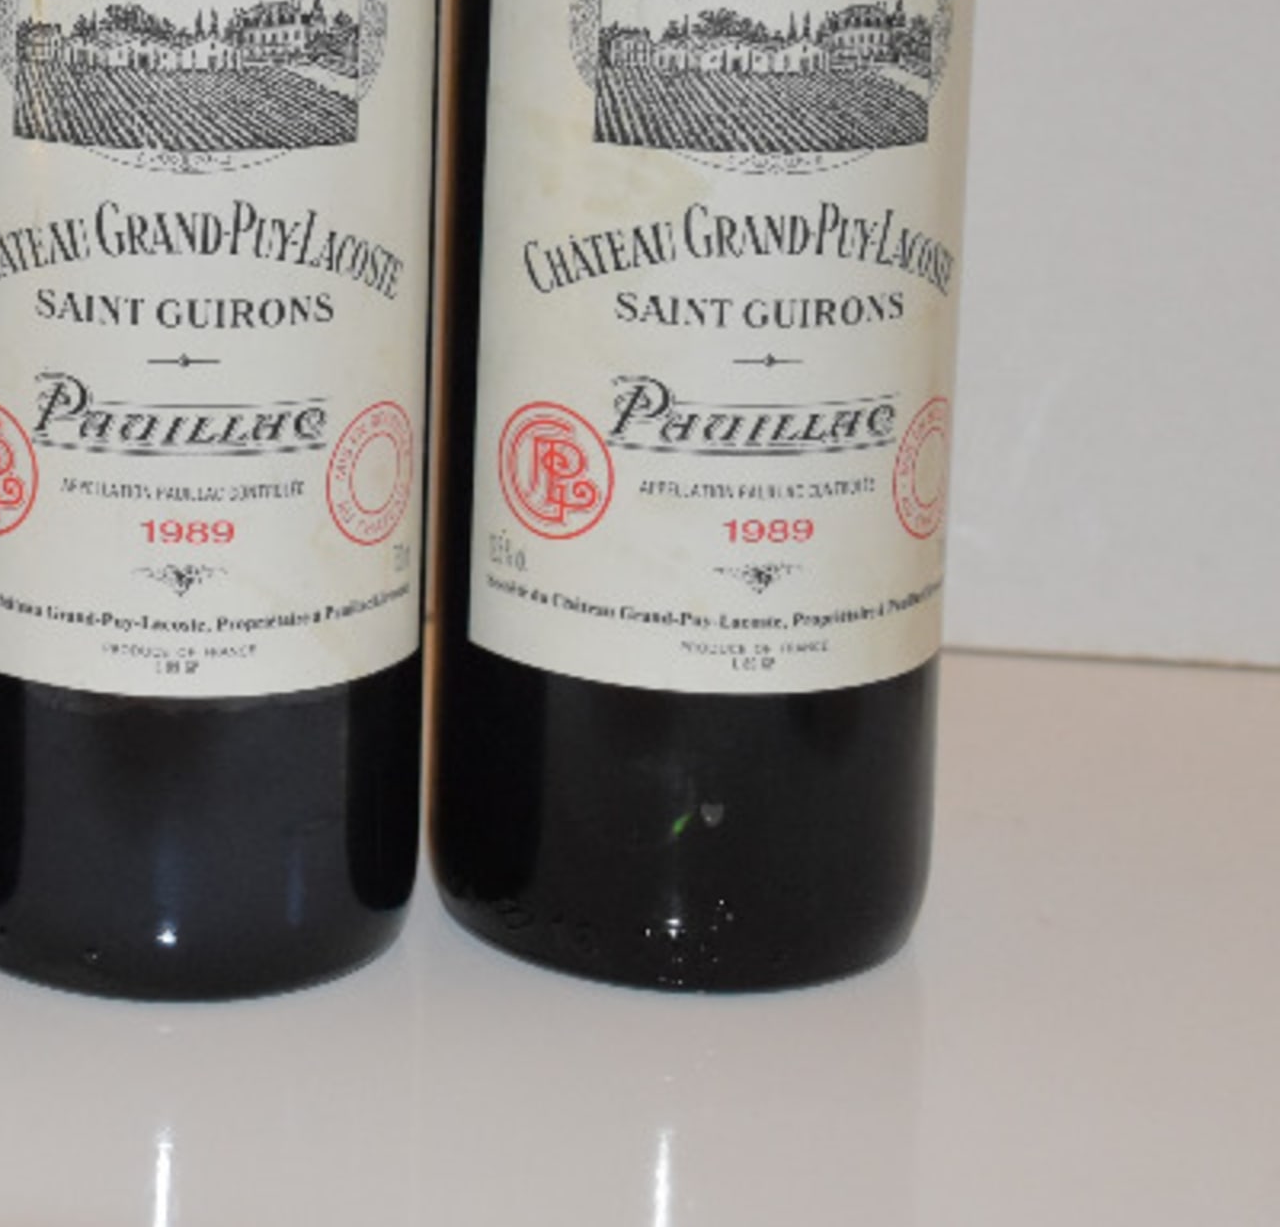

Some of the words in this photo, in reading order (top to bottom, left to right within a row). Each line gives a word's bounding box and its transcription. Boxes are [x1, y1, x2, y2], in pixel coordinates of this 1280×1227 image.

[35, 288, 145, 325] SAINT
[156, 293, 334, 329] GUIRONS
[615, 292, 733, 328] SAINT
[743, 292, 904, 329] GUIRONS
[139, 519, 236, 545] 1989
[723, 518, 815, 544] 1989
